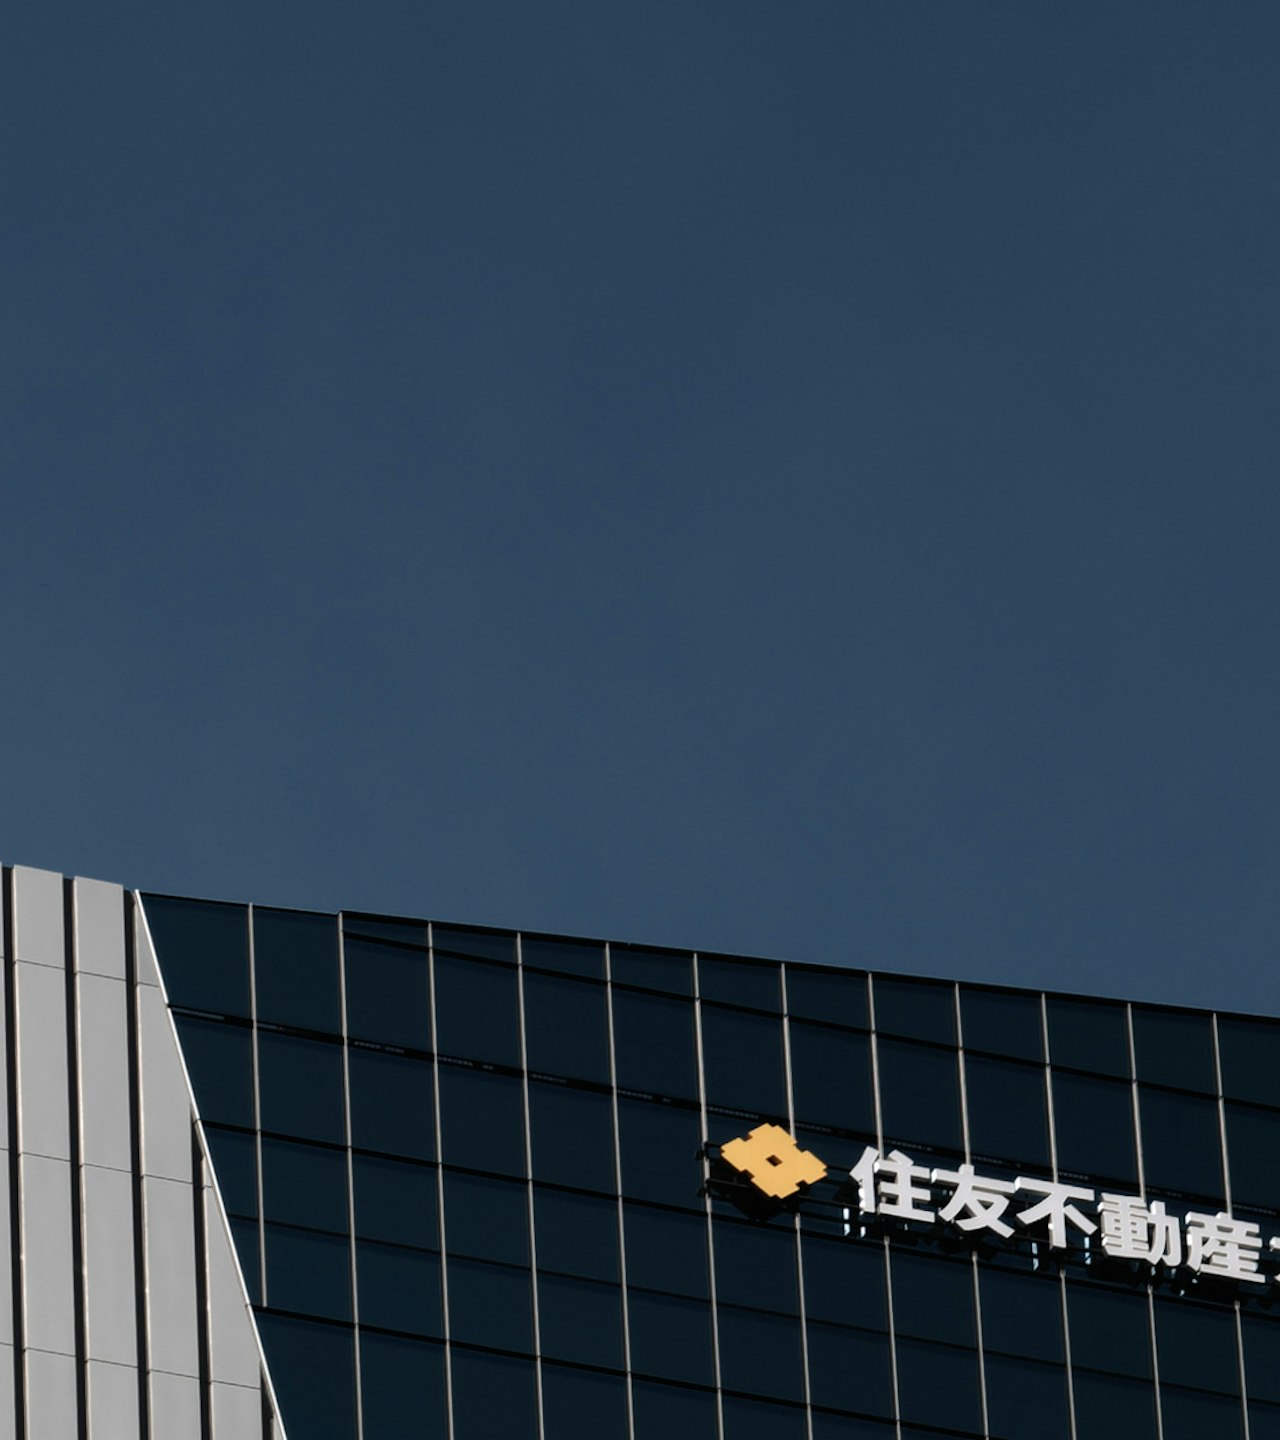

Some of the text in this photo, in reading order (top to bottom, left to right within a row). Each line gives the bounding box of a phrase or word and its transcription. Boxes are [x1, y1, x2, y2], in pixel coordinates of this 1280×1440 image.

[849, 1145, 1280, 1284] 住友不動産
